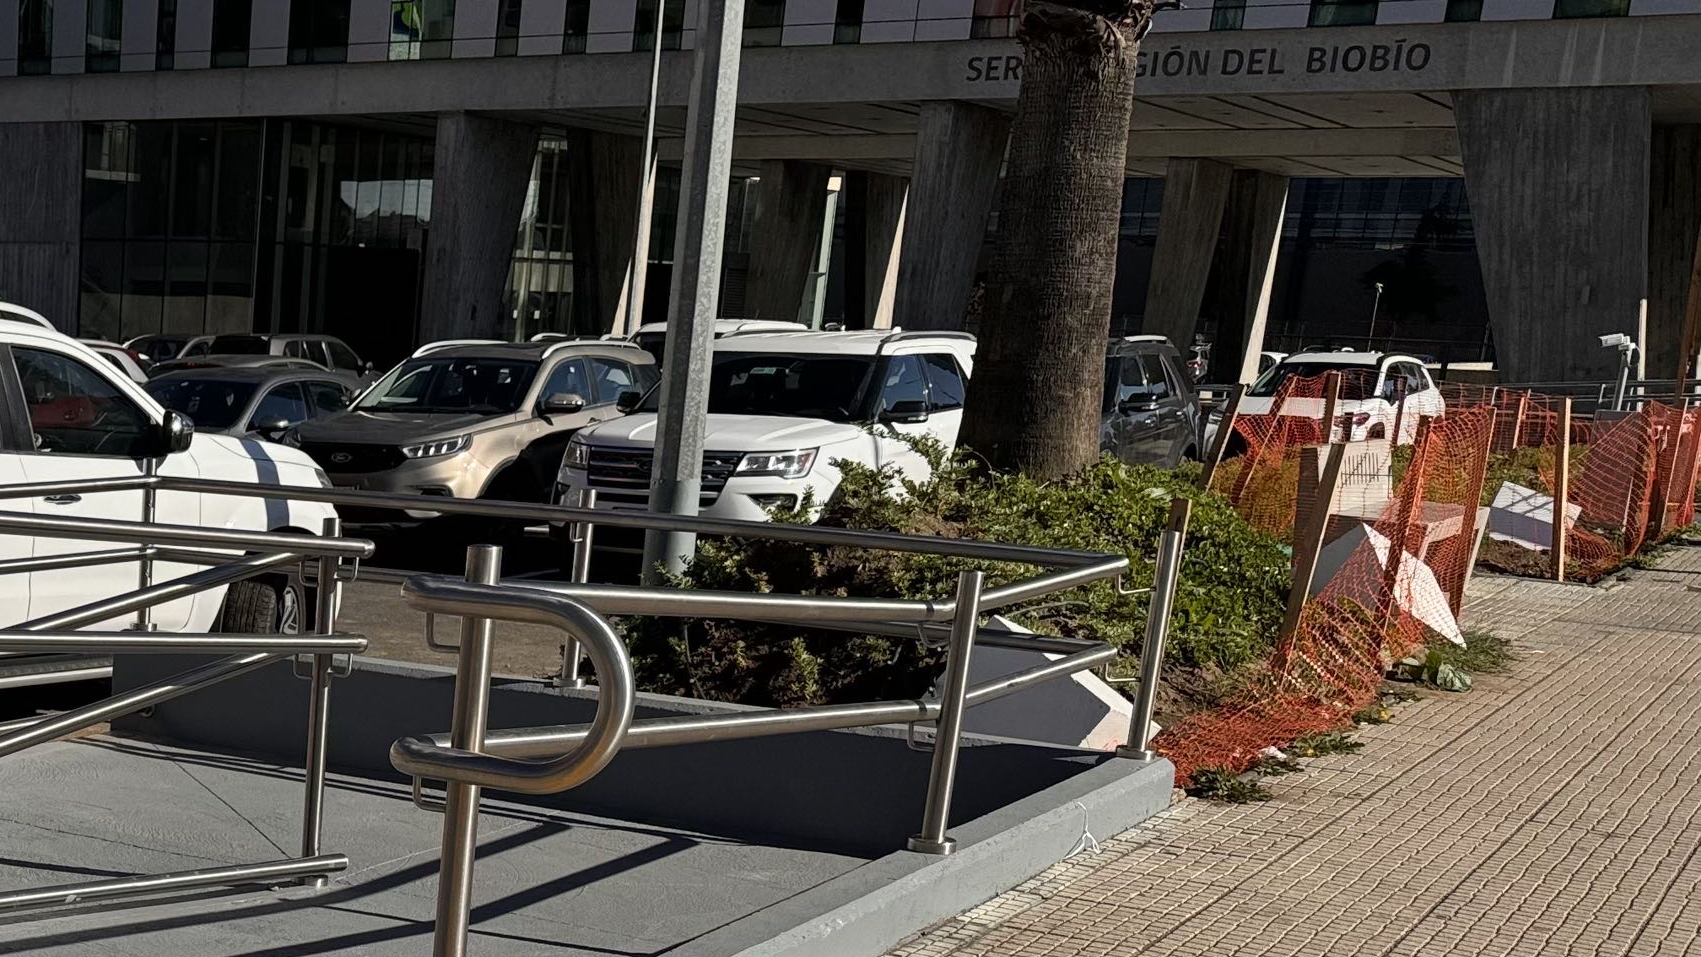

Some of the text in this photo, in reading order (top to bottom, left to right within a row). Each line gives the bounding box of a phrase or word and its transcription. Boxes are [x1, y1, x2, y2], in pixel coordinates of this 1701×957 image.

[965, 38, 1432, 82] SER GIÓN DEL BIOBÍO
